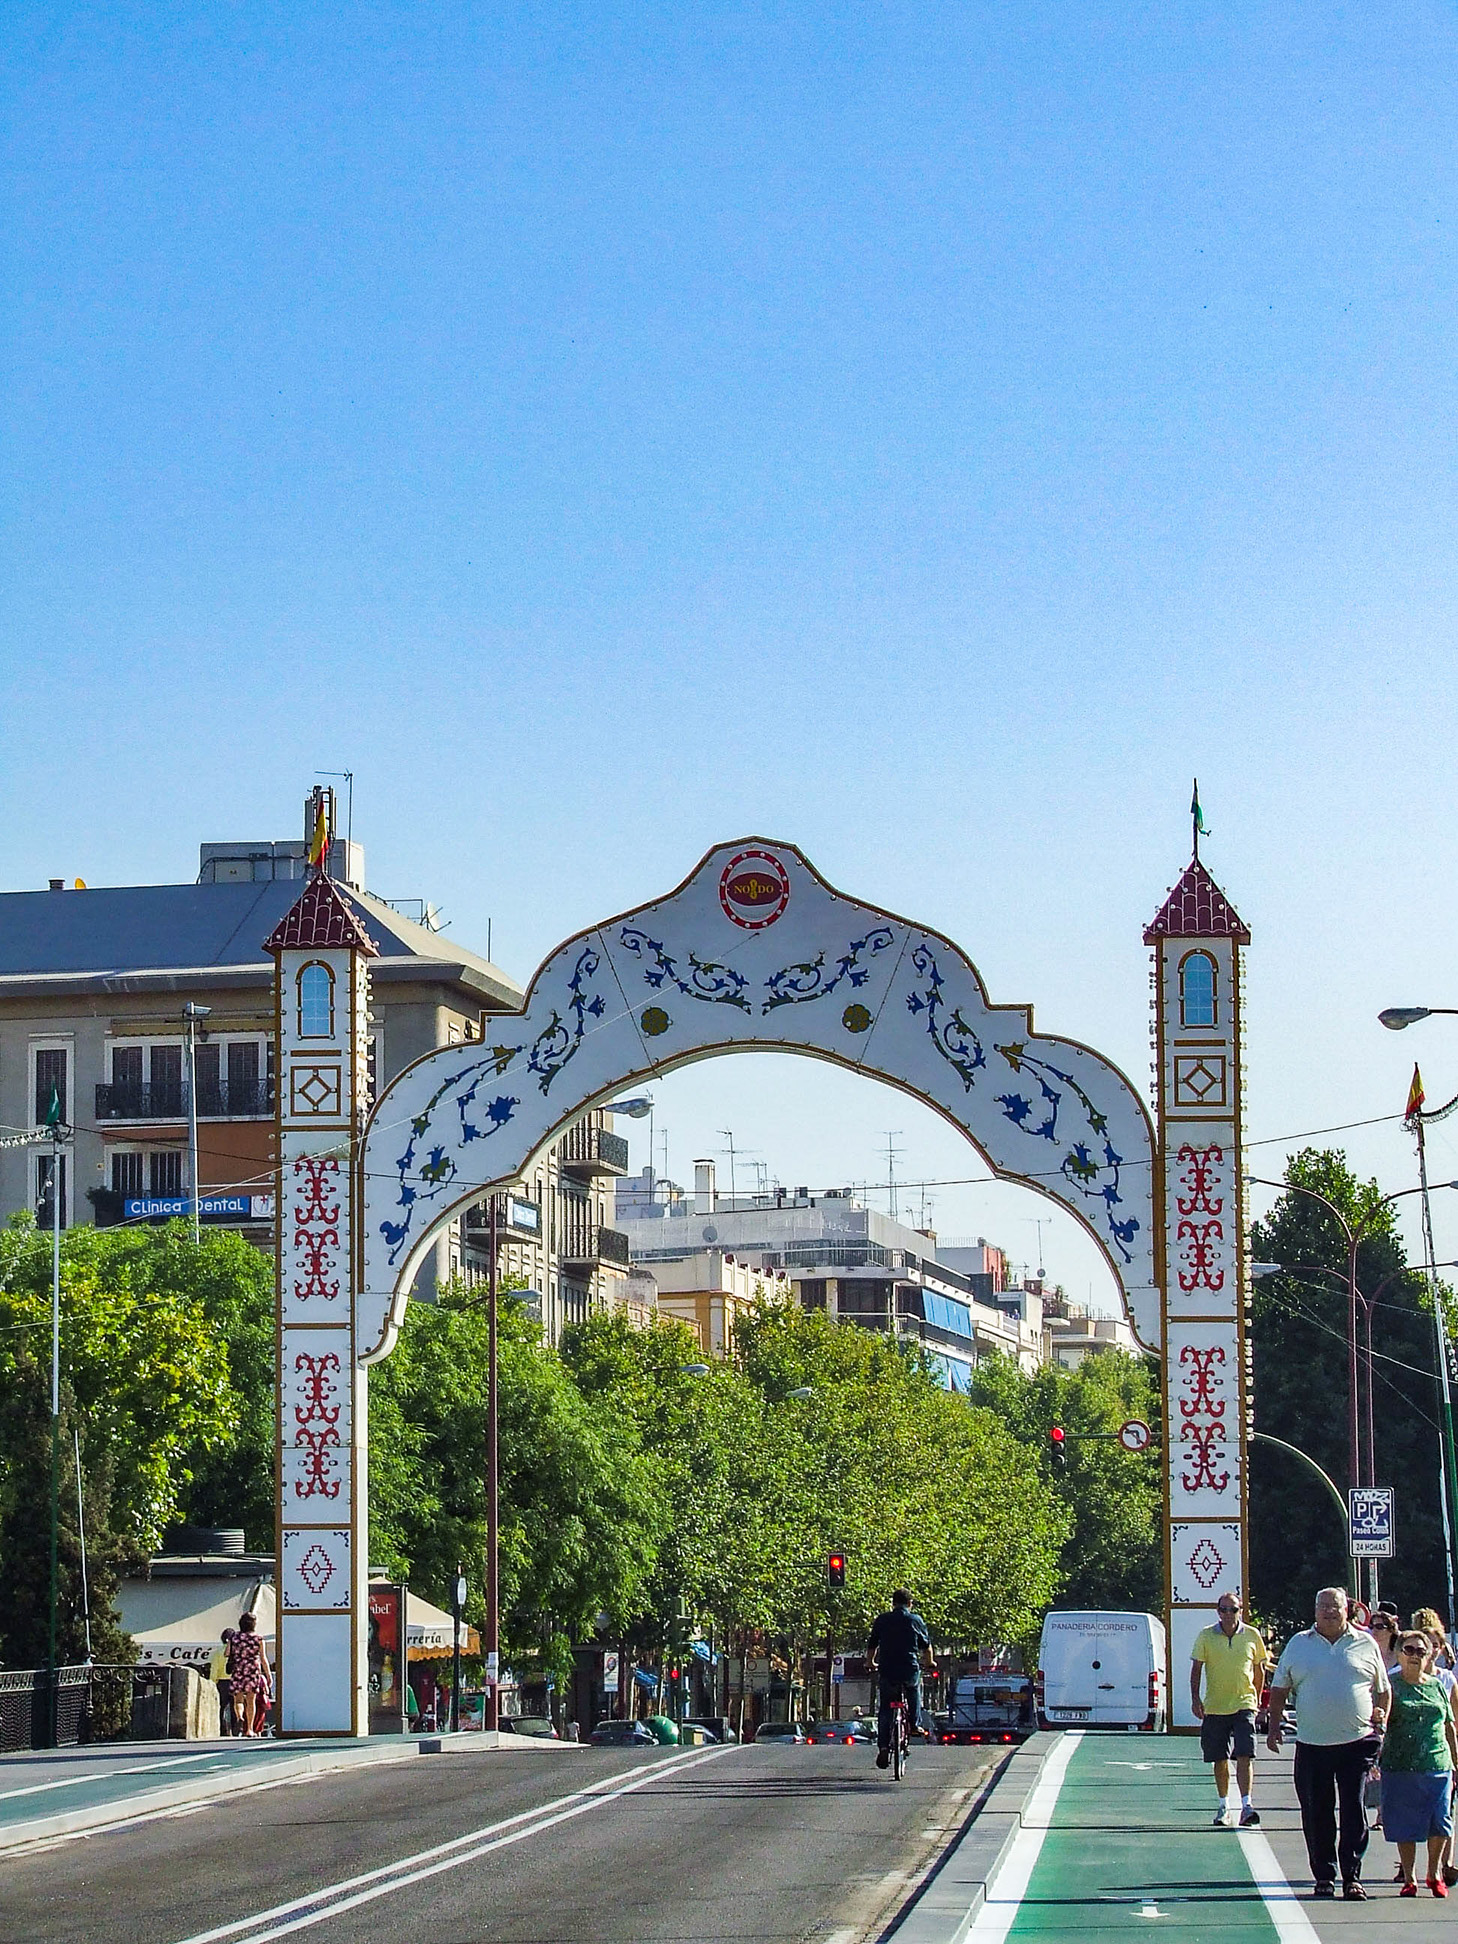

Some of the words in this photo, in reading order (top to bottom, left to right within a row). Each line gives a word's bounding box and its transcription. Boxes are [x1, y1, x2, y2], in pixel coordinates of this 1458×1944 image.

[1357, 1503, 1367, 1518] P
[1352, 1526, 1371, 1535] Paseo
[1356, 1543, 1364, 1551] 24
[1365, 1543, 1387, 1551] HORAS
[1051, 1623, 1096, 1631] PANADERIA
[1097, 1623, 1138, 1632] CORDERO
[170, 1646, 213, 1660] Café
